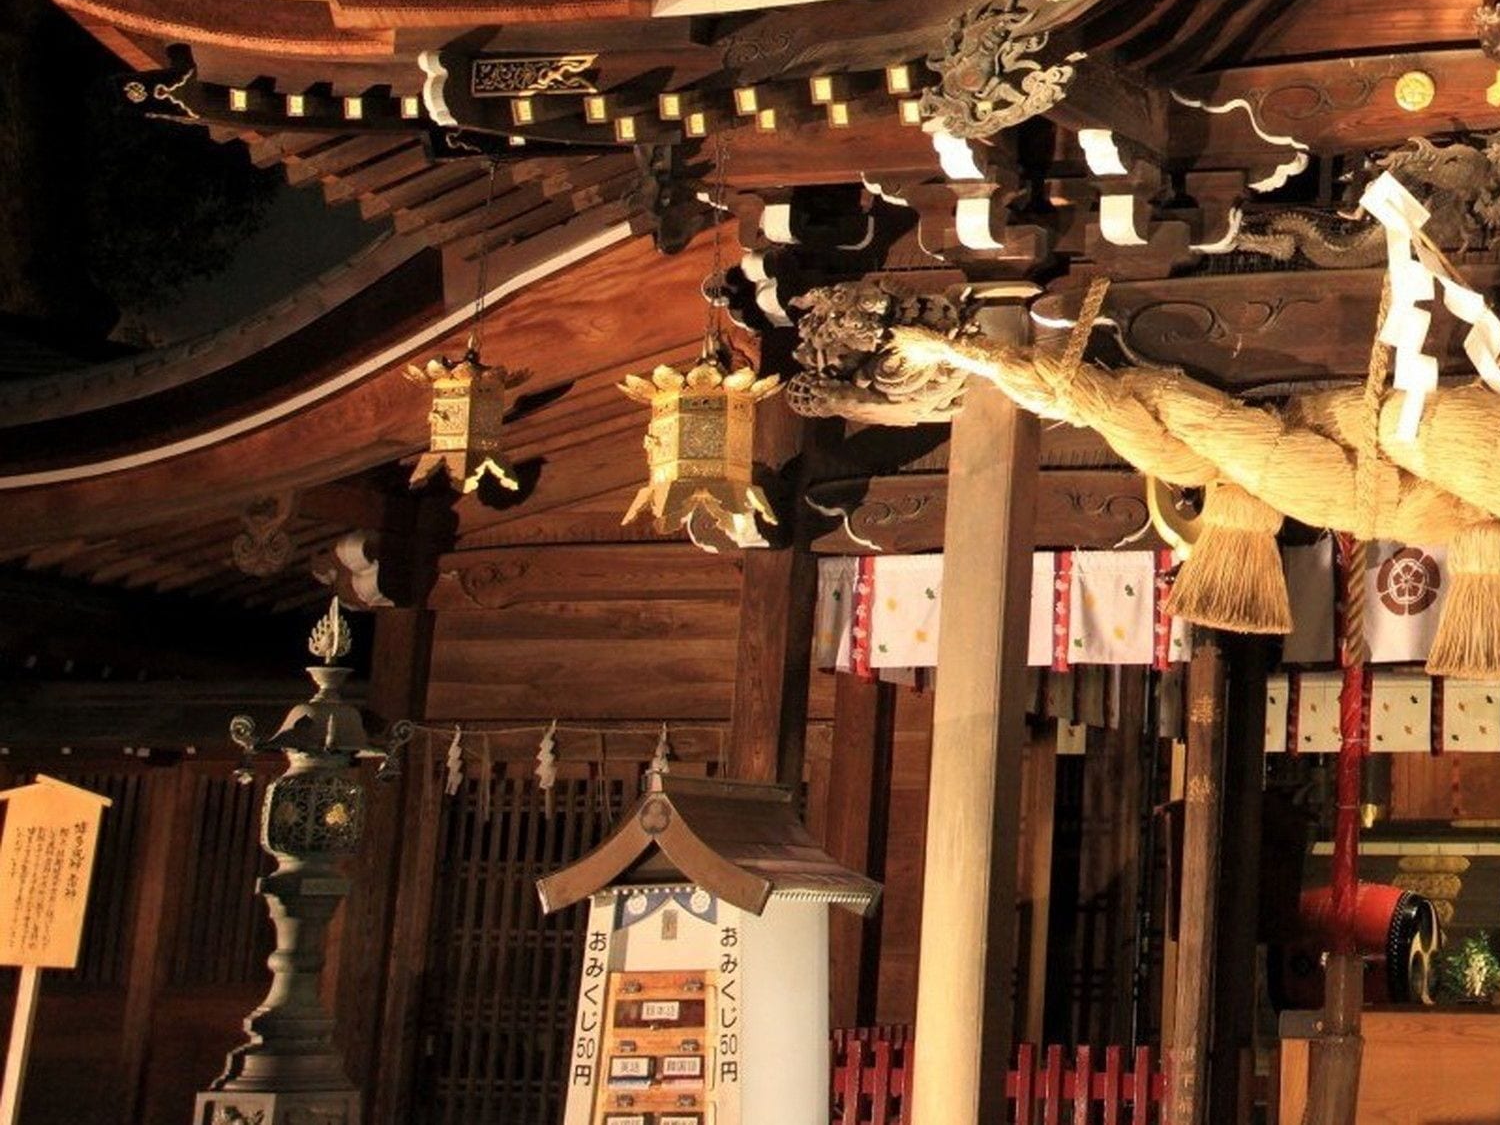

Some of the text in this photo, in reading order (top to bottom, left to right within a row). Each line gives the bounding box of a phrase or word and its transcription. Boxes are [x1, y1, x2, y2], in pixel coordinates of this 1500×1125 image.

[573, 931, 607, 1086] おみくじ50円
[720, 927, 738, 1083] おみくじ50円
